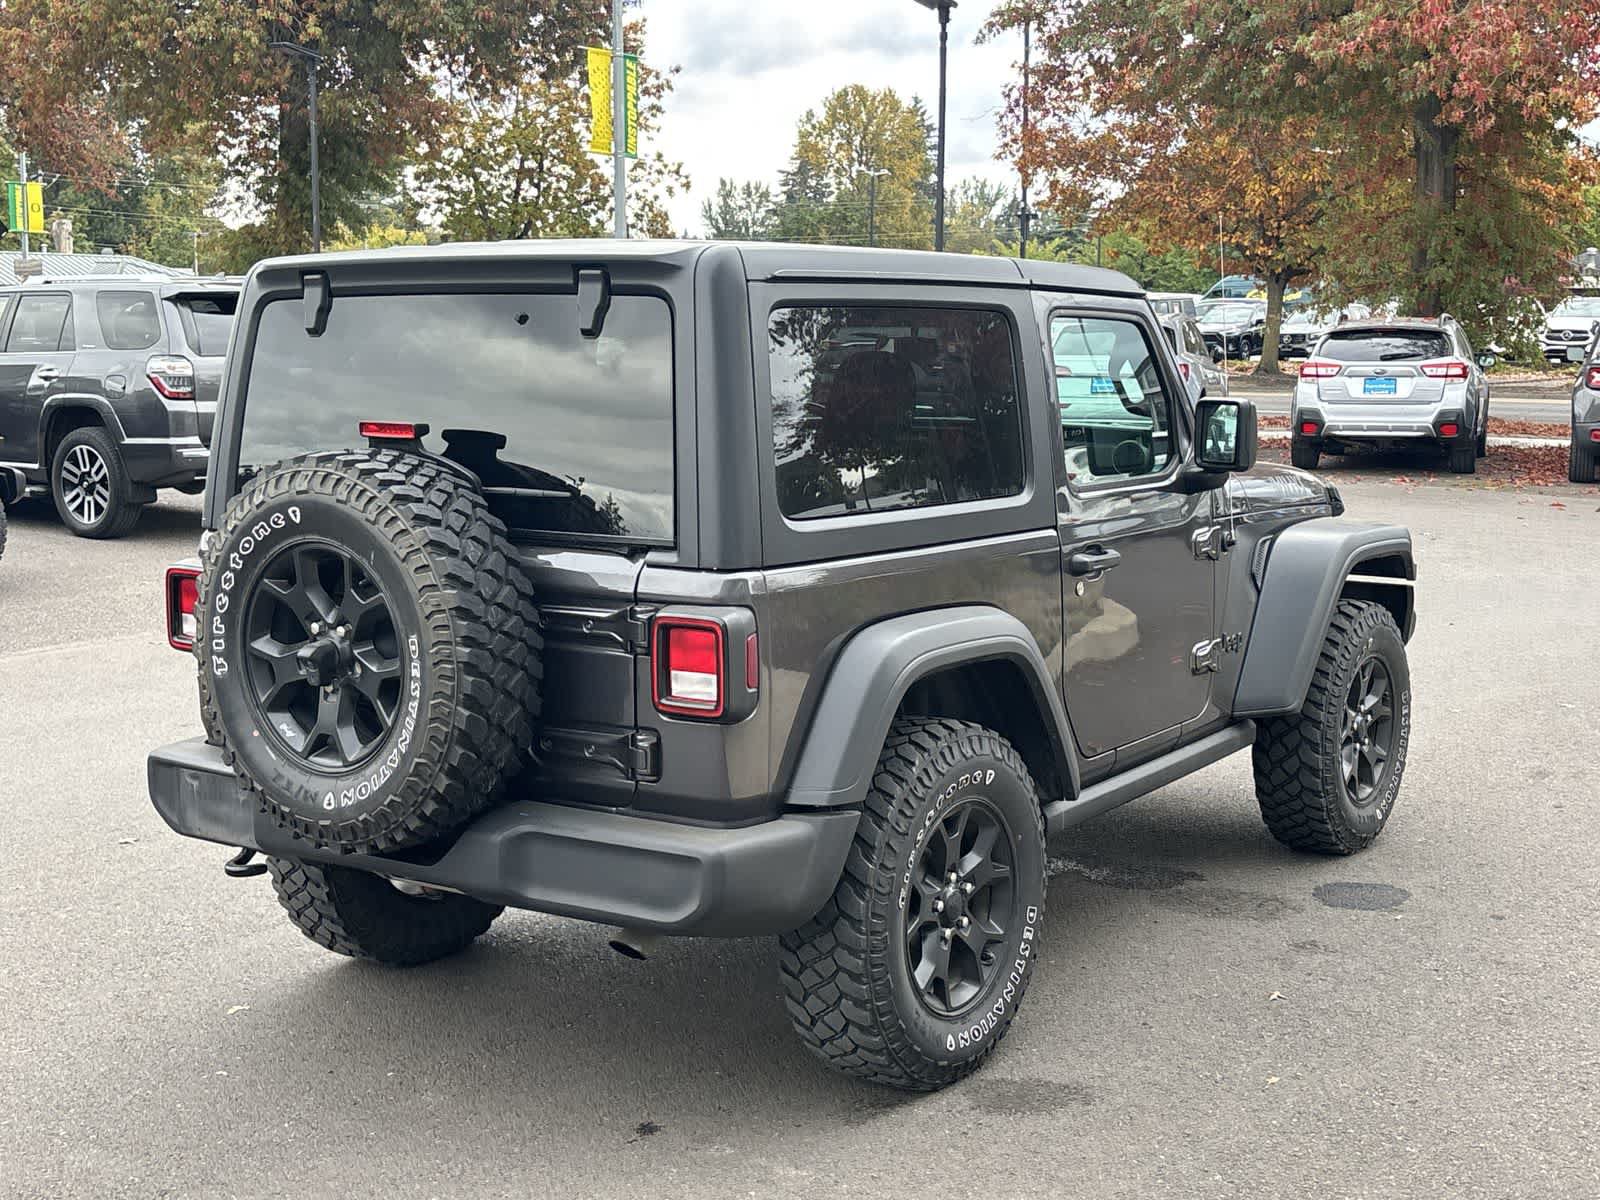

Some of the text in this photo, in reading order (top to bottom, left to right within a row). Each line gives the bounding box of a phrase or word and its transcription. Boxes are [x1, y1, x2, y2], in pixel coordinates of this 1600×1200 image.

[626, 58, 637, 155] UNSTOPPABLE
[341, 634, 421, 808] DESTINATION
[958, 905, 1038, 1048] DESTINATION
